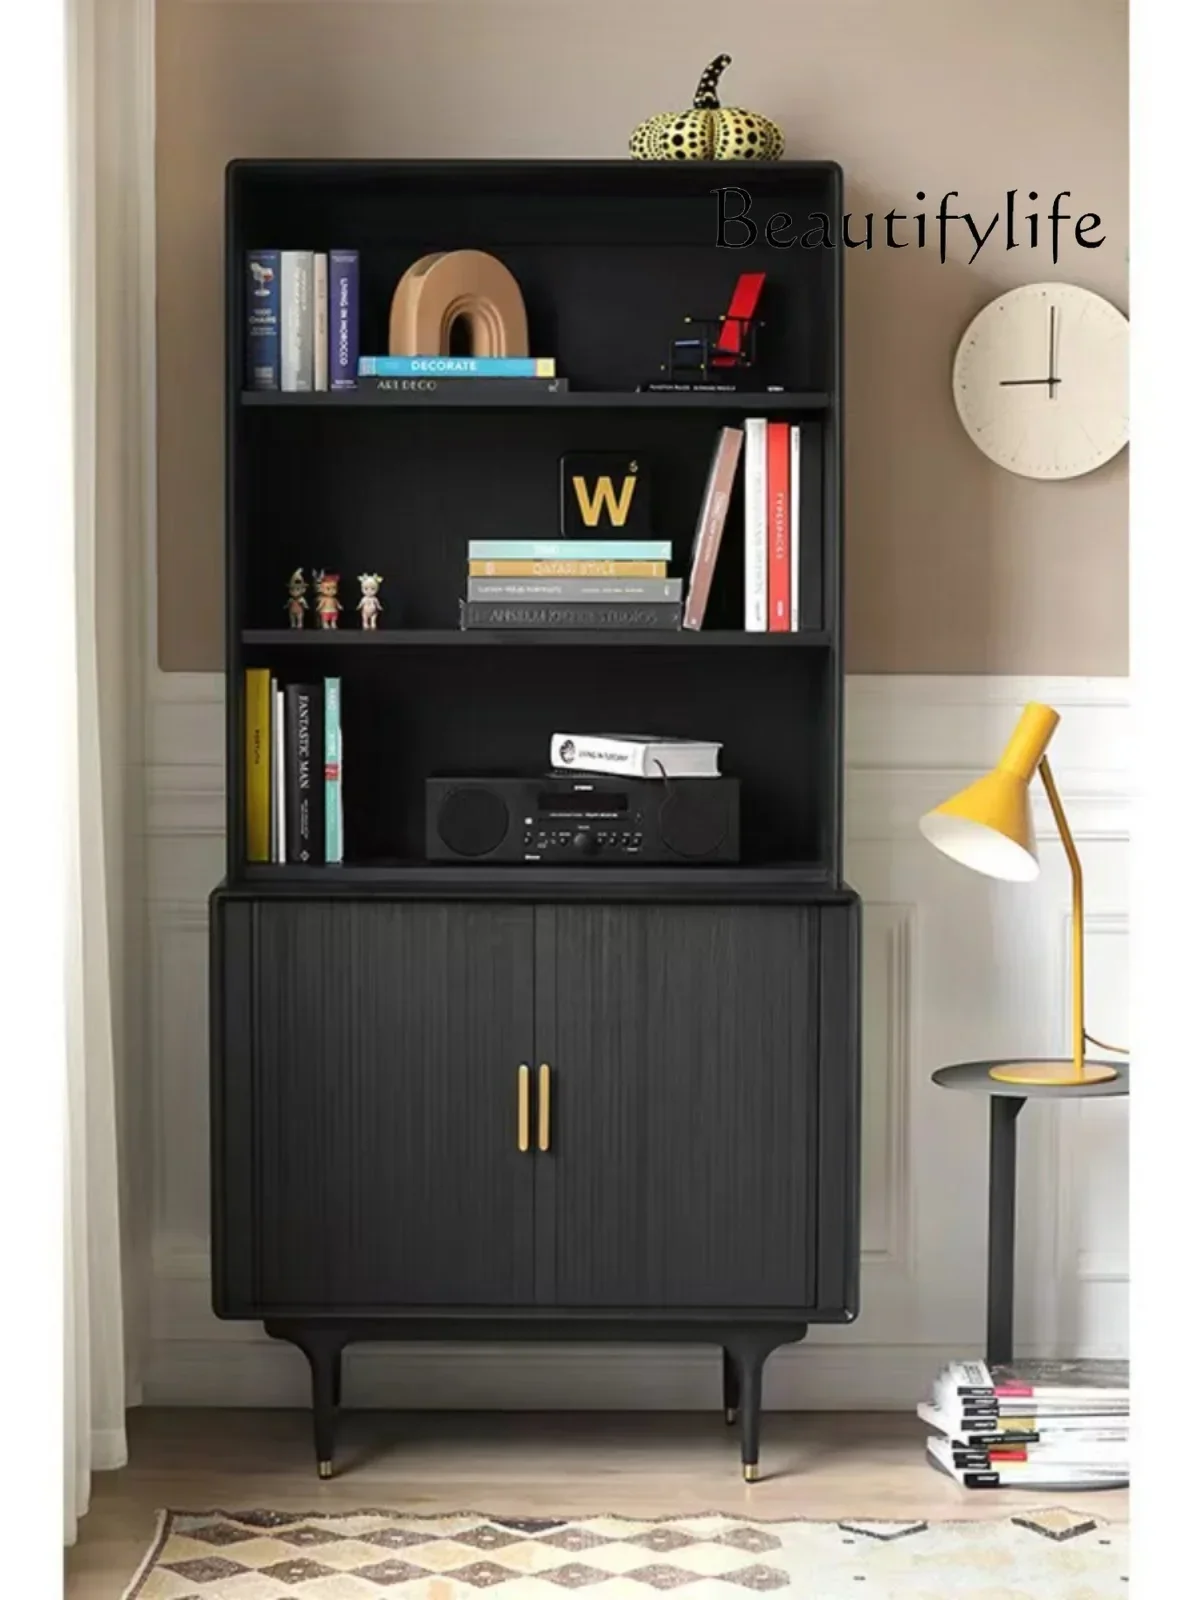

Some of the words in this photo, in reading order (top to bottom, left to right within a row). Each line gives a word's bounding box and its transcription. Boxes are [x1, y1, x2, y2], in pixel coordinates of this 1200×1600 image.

[339, 320, 349, 366] MOROCCO
[411, 360, 477, 371] DECORATE
[572, 476, 637, 527] W
[298, 695, 310, 756] FANTASTIC
[299, 760, 310, 789] MAN
